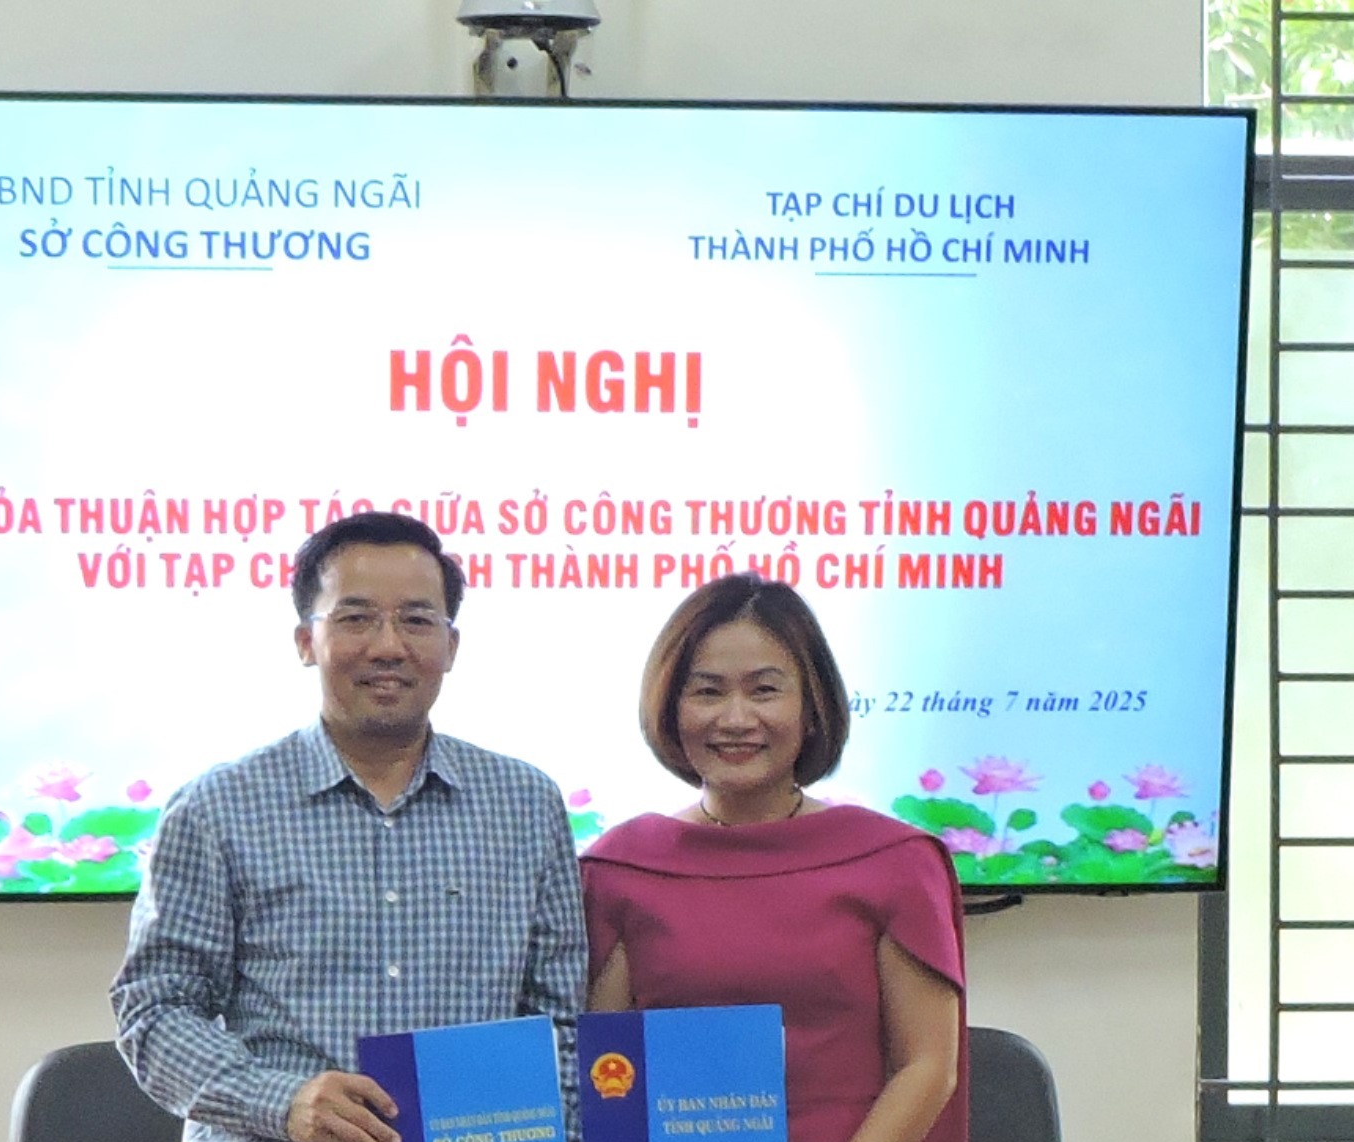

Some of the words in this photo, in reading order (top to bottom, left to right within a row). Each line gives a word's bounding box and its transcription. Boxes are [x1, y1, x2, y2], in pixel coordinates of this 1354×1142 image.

[85, 166, 170, 206] TỈNH
[185, 167, 319, 210] QUẢNG
[334, 173, 421, 208] NGÃI
[766, 192, 822, 222] TẠP
[832, 186, 884, 218] CHÍ
[894, 194, 939, 218] DU
[950, 194, 1016, 223] LỊCH
[19, 218, 71, 258] SỞ
[82, 222, 188, 258] CÔNG
[199, 228, 371, 260] THƯƠNG
[688, 229, 798, 260] THÀNH
[809, 228, 876, 262] PHỐ
[886, 228, 932, 263] HỒ
[942, 232, 994, 262] CHÍ
[1003, 239, 1090, 264] MINH
[390, 333, 508, 427] HỘI
[537, 350, 702, 429] NGHỊ
[54, 489, 189, 543] THUẬN
[203, 493, 286, 543] HỢP
[498, 488, 549, 536] SỞ
[563, 491, 673, 536] CÔNG
[684, 495, 847, 536] THƯƠNG
[859, 489, 952, 536] TỈNH
[963, 490, 1098, 540] QUẢNG
[1109, 493, 1202, 536] NGÃI
[78, 543, 146, 588] VỚI
[159, 553, 236, 596] TẠP
[506, 544, 639, 589] THÀNH
[653, 541, 736, 588] PHỐ
[816, 545, 885, 589] CHÍ
[898, 553, 1003, 589] MINH
[884, 690, 914, 713] 22
[921, 691, 994, 718] tháng
[1005, 690, 1019, 712] 7
[1025, 692, 1080, 712] năm
[1087, 690, 1149, 712] 2025
